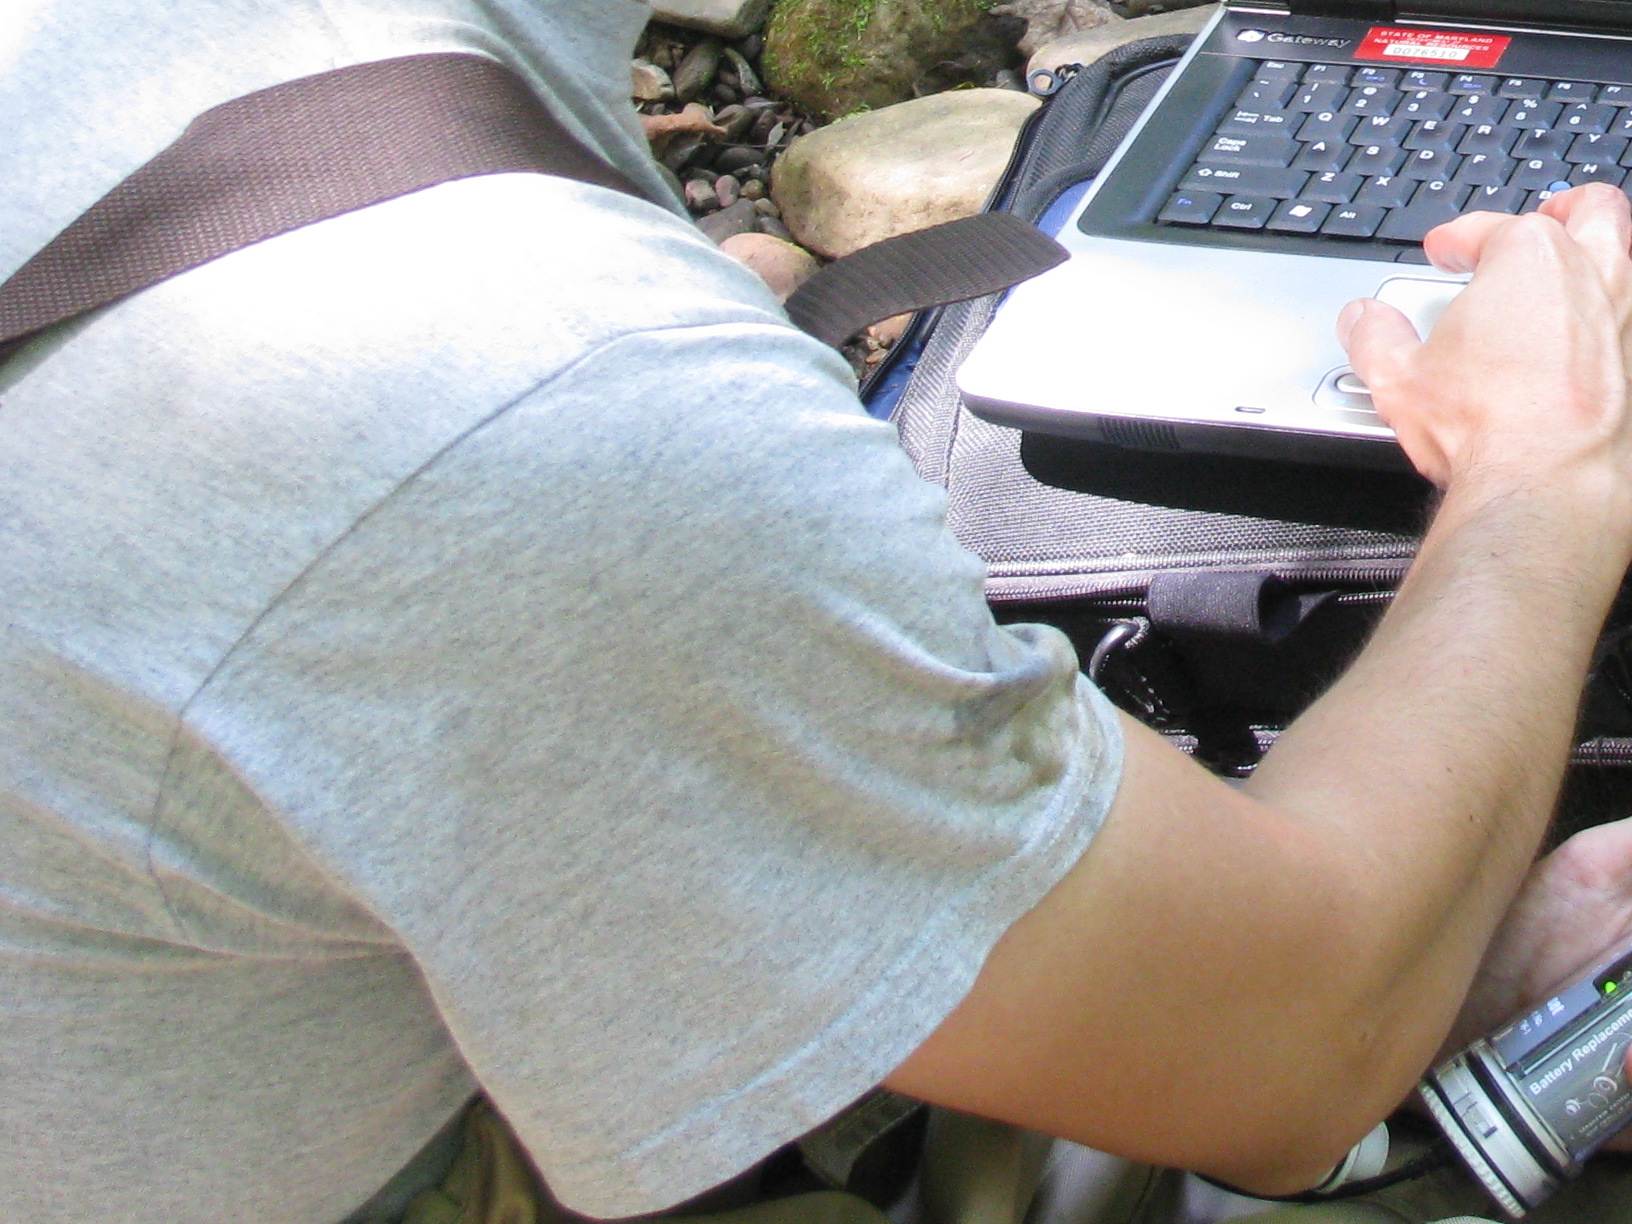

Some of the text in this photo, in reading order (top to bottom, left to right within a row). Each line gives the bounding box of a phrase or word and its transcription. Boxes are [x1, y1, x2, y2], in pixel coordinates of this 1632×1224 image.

[1267, 32, 1351, 49] Gateway
[1435, 35, 1493, 44] MARYLAND
[1426, 41, 1490, 51] RESOURCES
[1393, 47, 1458, 58] 0076510
[1355, 99, 1368, 108] 2
[1408, 103, 1419, 112] 3
[1523, 99, 1537, 109] %
[1319, 112, 1333, 122] Q
[1462, 108, 1472, 117] 4
[1263, 114, 1284, 124] Tab
[1372, 116, 1390, 125] W
[1570, 116, 1581, 125] 6
[1424, 121, 1437, 130] E
[1478, 125, 1492, 135] R
[1534, 129, 1546, 138] T
[1589, 134, 1602, 143] Y
[1214, 144, 1241, 152] Lock
[1312, 141, 1326, 151] A
[1366, 146, 1380, 155] S
[1420, 150, 1434, 160] D
[1473, 155, 1487, 164] F
[1529, 160, 1543, 169] G
[1583, 164, 1598, 173] H
[1214, 170, 1241, 179] Shift
[1320, 173, 1336, 182] Z
[1375, 176, 1391, 186] X
[1429, 181, 1444, 191] C
[1486, 186, 1499, 196] V
[1231, 203, 1253, 211] Ctrl
[1339, 211, 1356, 219] Alt
[1529, 1055, 1575, 1097] Battery
